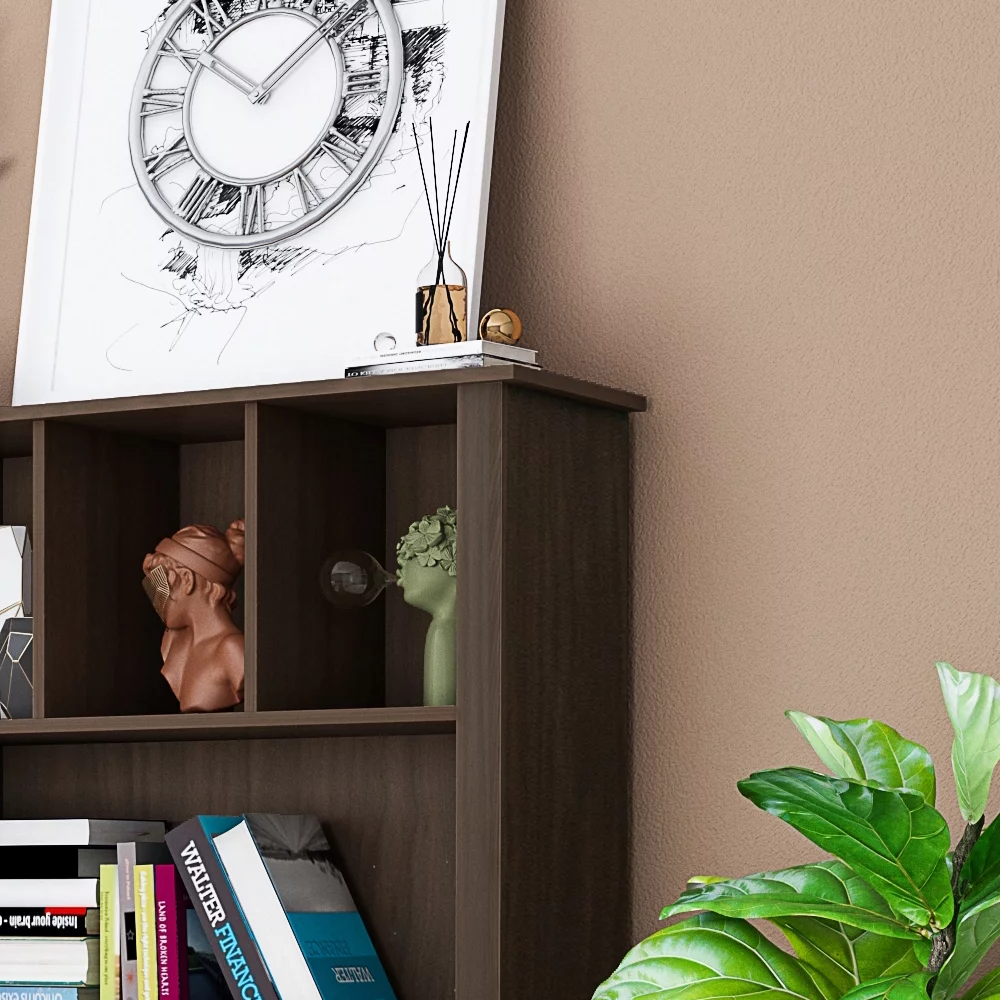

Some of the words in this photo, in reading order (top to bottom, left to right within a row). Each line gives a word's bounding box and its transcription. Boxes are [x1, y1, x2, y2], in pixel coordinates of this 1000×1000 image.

[180, 840, 227, 928] WALTER
[31, 912, 51, 927] your
[157, 901, 167, 922] LAND
[9, 915, 31, 928] brain
[52, 915, 78, 929] Inside
[158, 924, 168, 934] OF
[159, 935, 169, 964] BROKEN
[304, 939, 352, 957] FINANCE
[160, 966, 170, 996] HEARTS
[331, 966, 375, 983] WALTER
